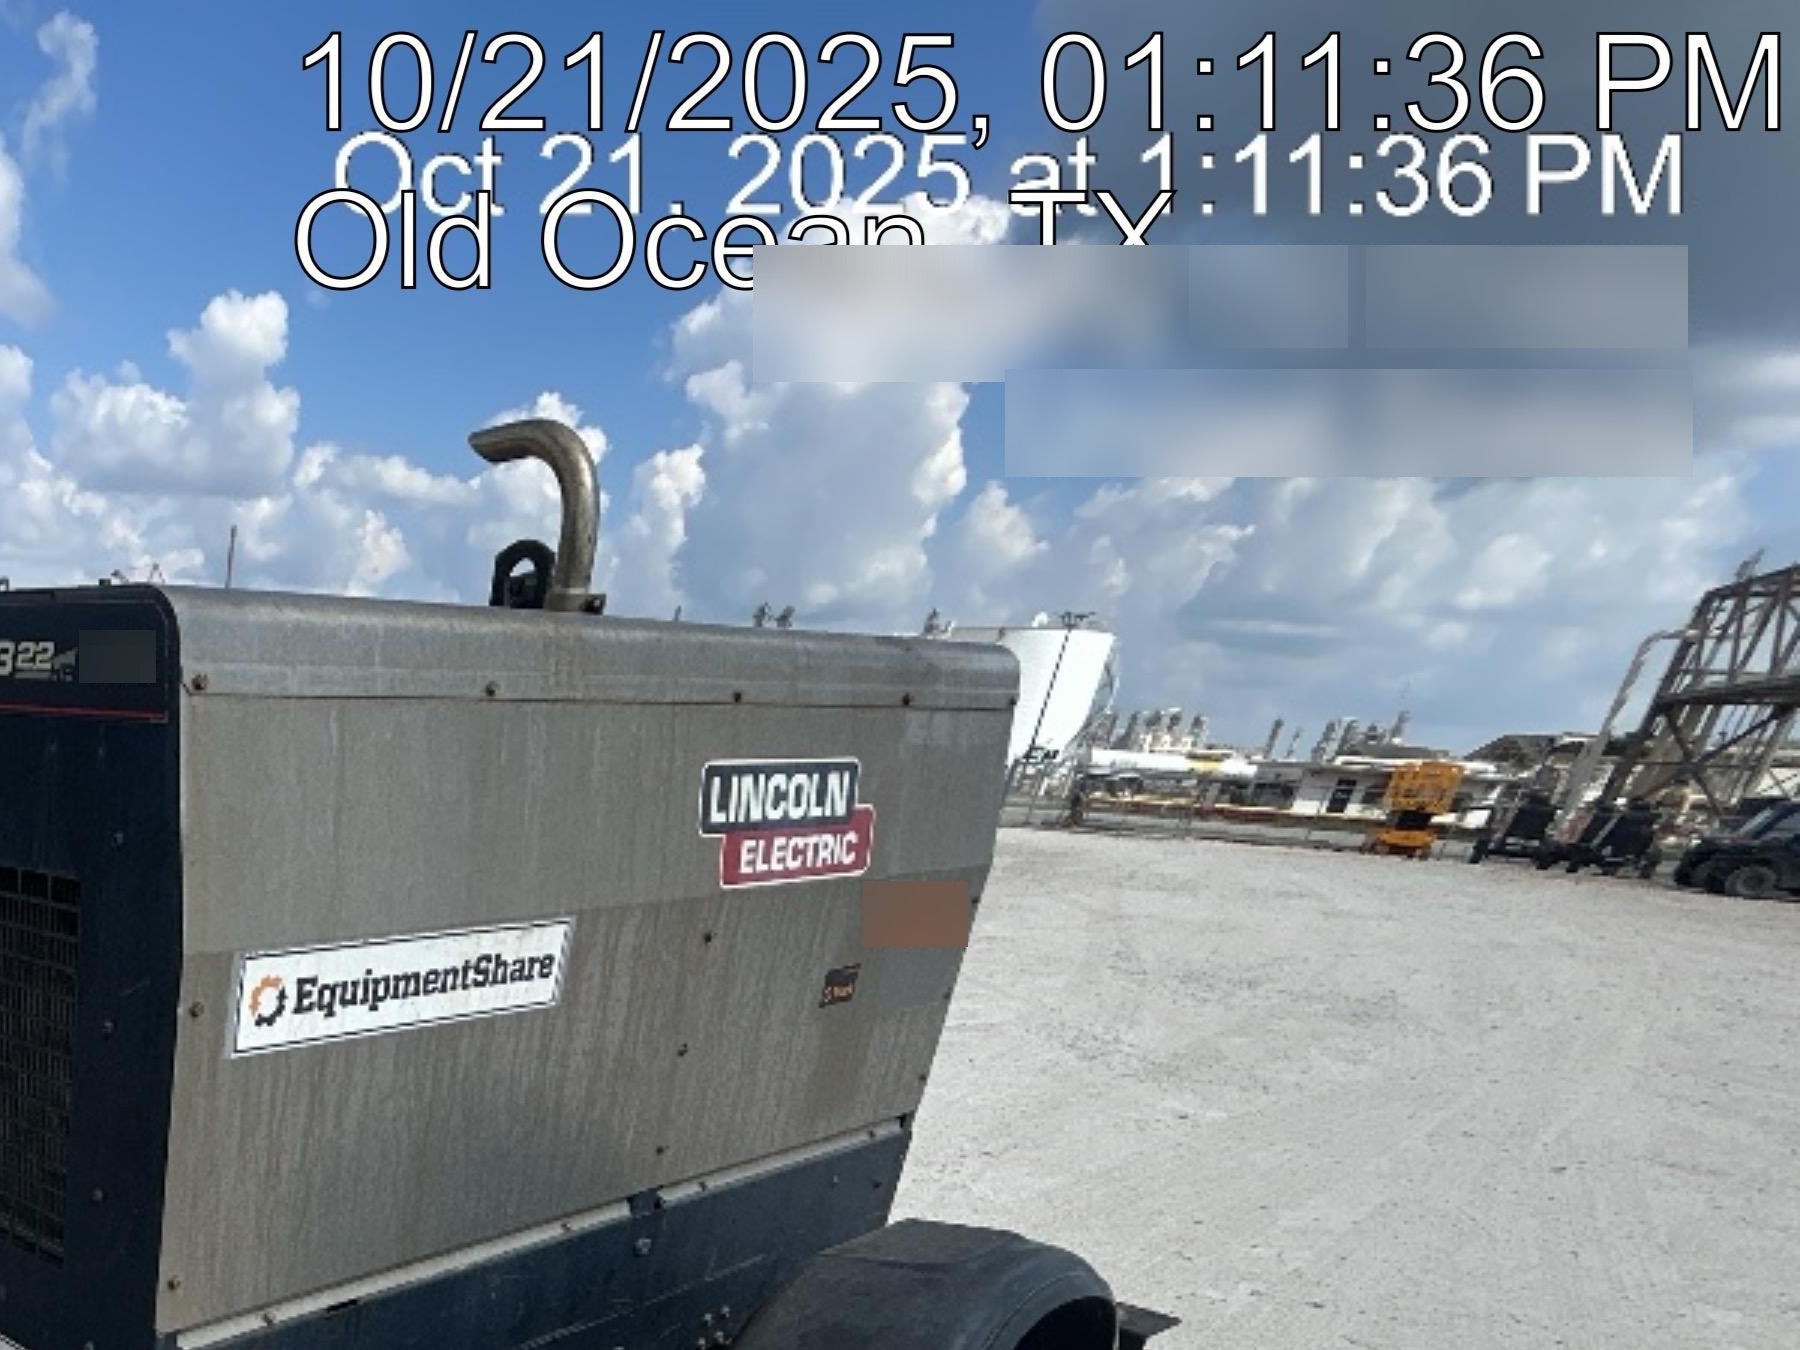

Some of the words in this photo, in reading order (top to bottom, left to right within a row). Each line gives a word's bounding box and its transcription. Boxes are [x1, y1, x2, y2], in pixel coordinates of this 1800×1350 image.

[709, 770, 851, 823] LINCOLN
[738, 830, 859, 874] ELECTRIC
[291, 953, 556, 1018] EquipmentShare
